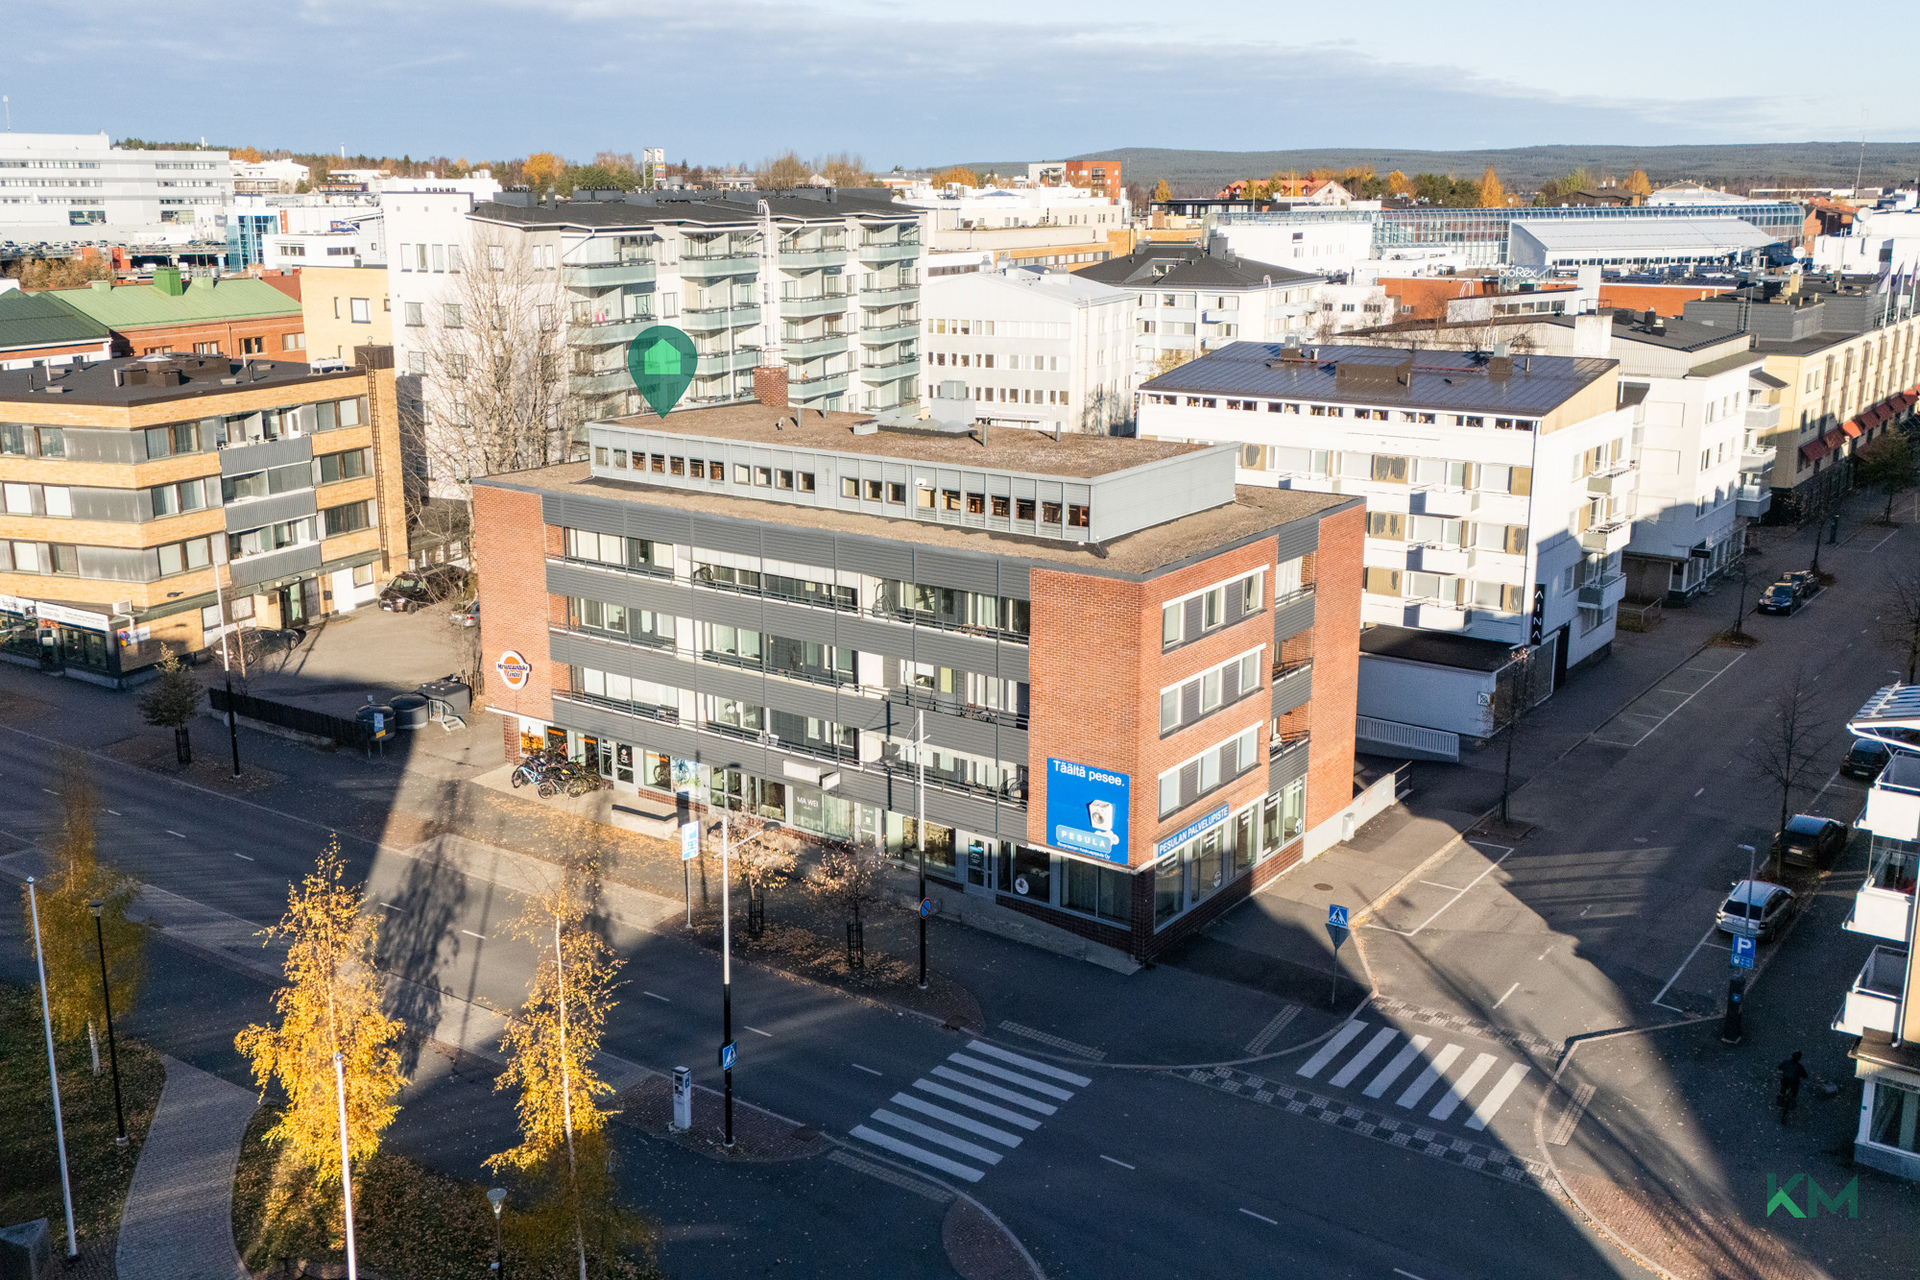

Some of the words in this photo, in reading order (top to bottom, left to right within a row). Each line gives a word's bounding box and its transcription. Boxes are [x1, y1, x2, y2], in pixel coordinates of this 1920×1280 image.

[1499, 266, 1537, 278] bioRex
[1532, 590, 1544, 639] AINA
[1053, 760, 1086, 778] Täältä
[1089, 771, 1125, 787] pesee.
[1061, 830, 1106, 848] PESULA
[1159, 831, 1187, 854] PESULAN
[1187, 807, 1229, 838] PALVELUPISTE
[1737, 937, 1752, 954] P
